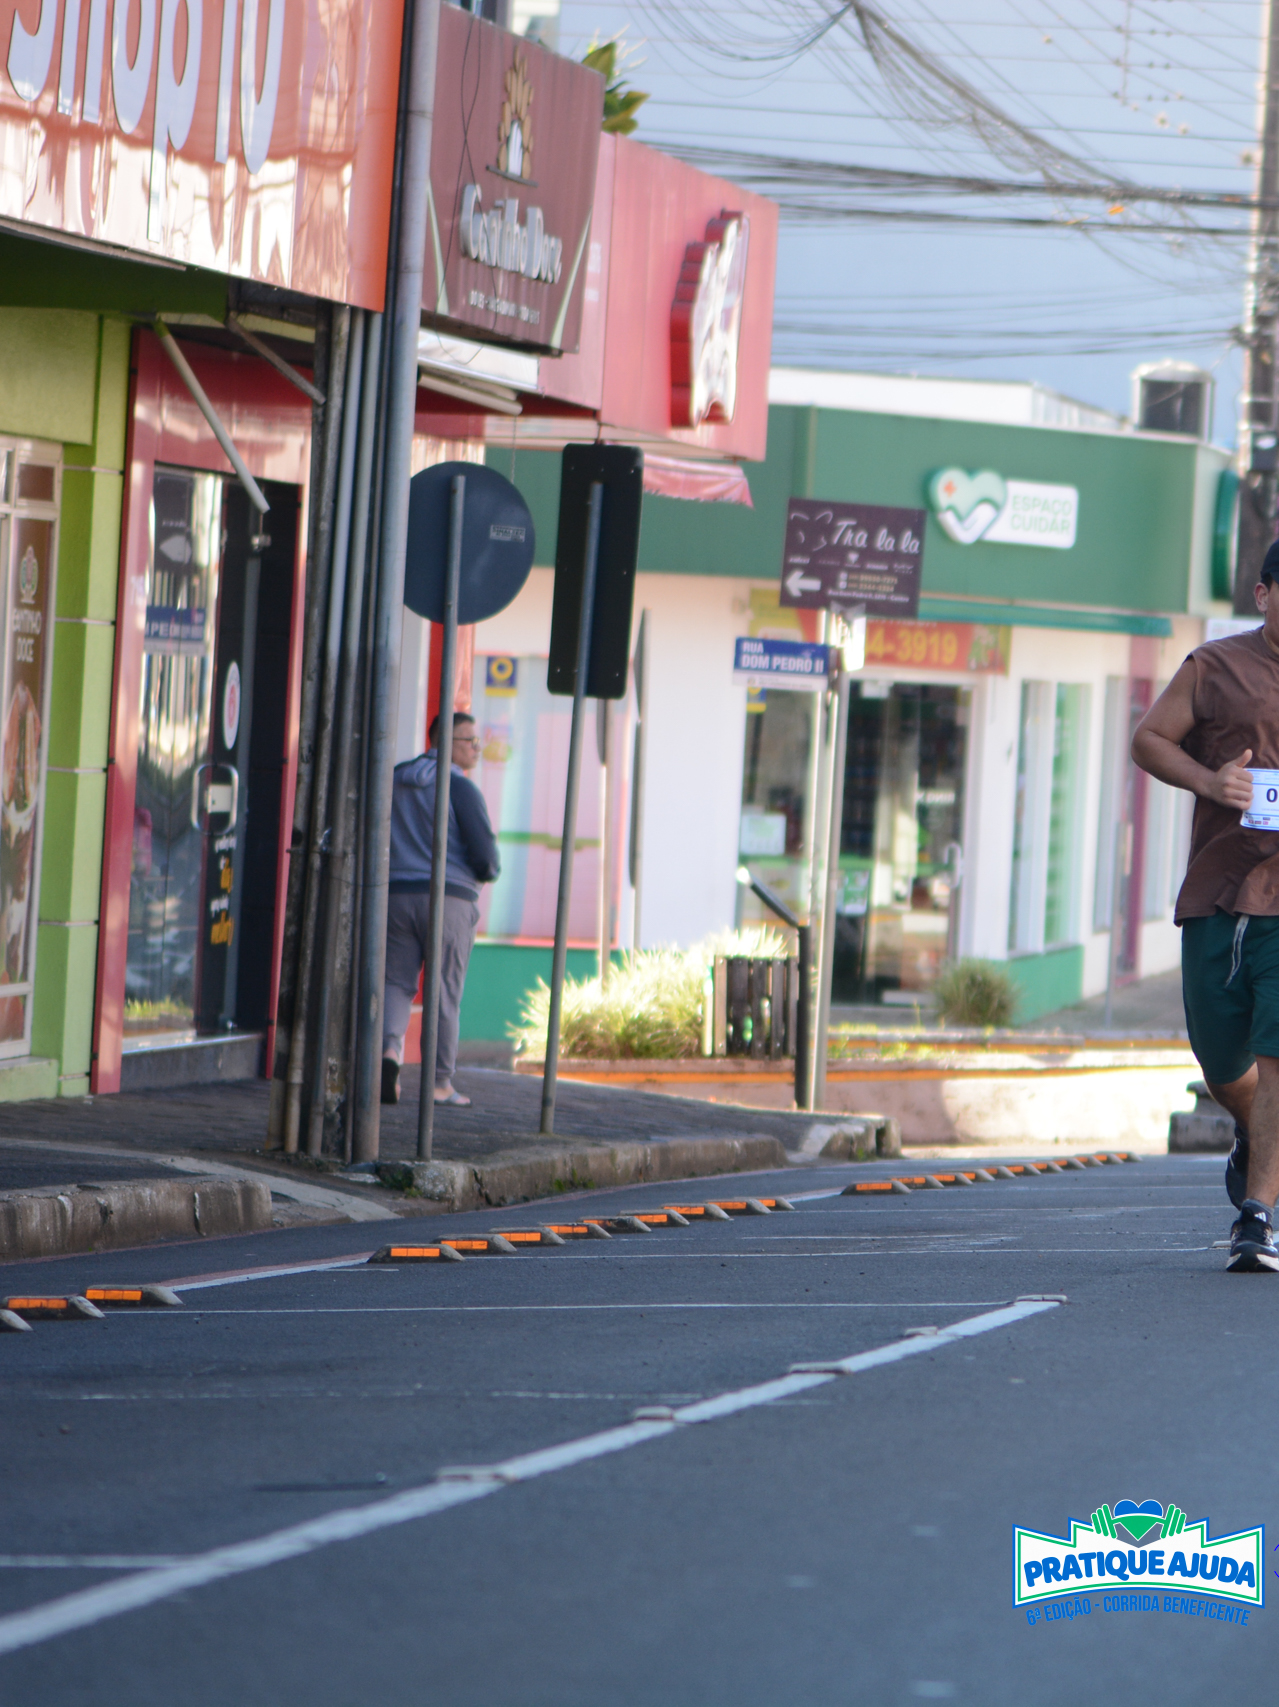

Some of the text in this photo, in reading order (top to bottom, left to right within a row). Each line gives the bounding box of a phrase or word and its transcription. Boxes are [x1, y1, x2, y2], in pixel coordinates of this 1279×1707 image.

[1012, 495, 1073, 517] ESPAÇO
[1010, 514, 1071, 536] CUIDAR
[832, 521, 920, 554] Tra la la
[742, 641, 764, 654] RUA
[865, 626, 958, 665] 4-3919
[741, 654, 824, 673] DOM PEDRO II
